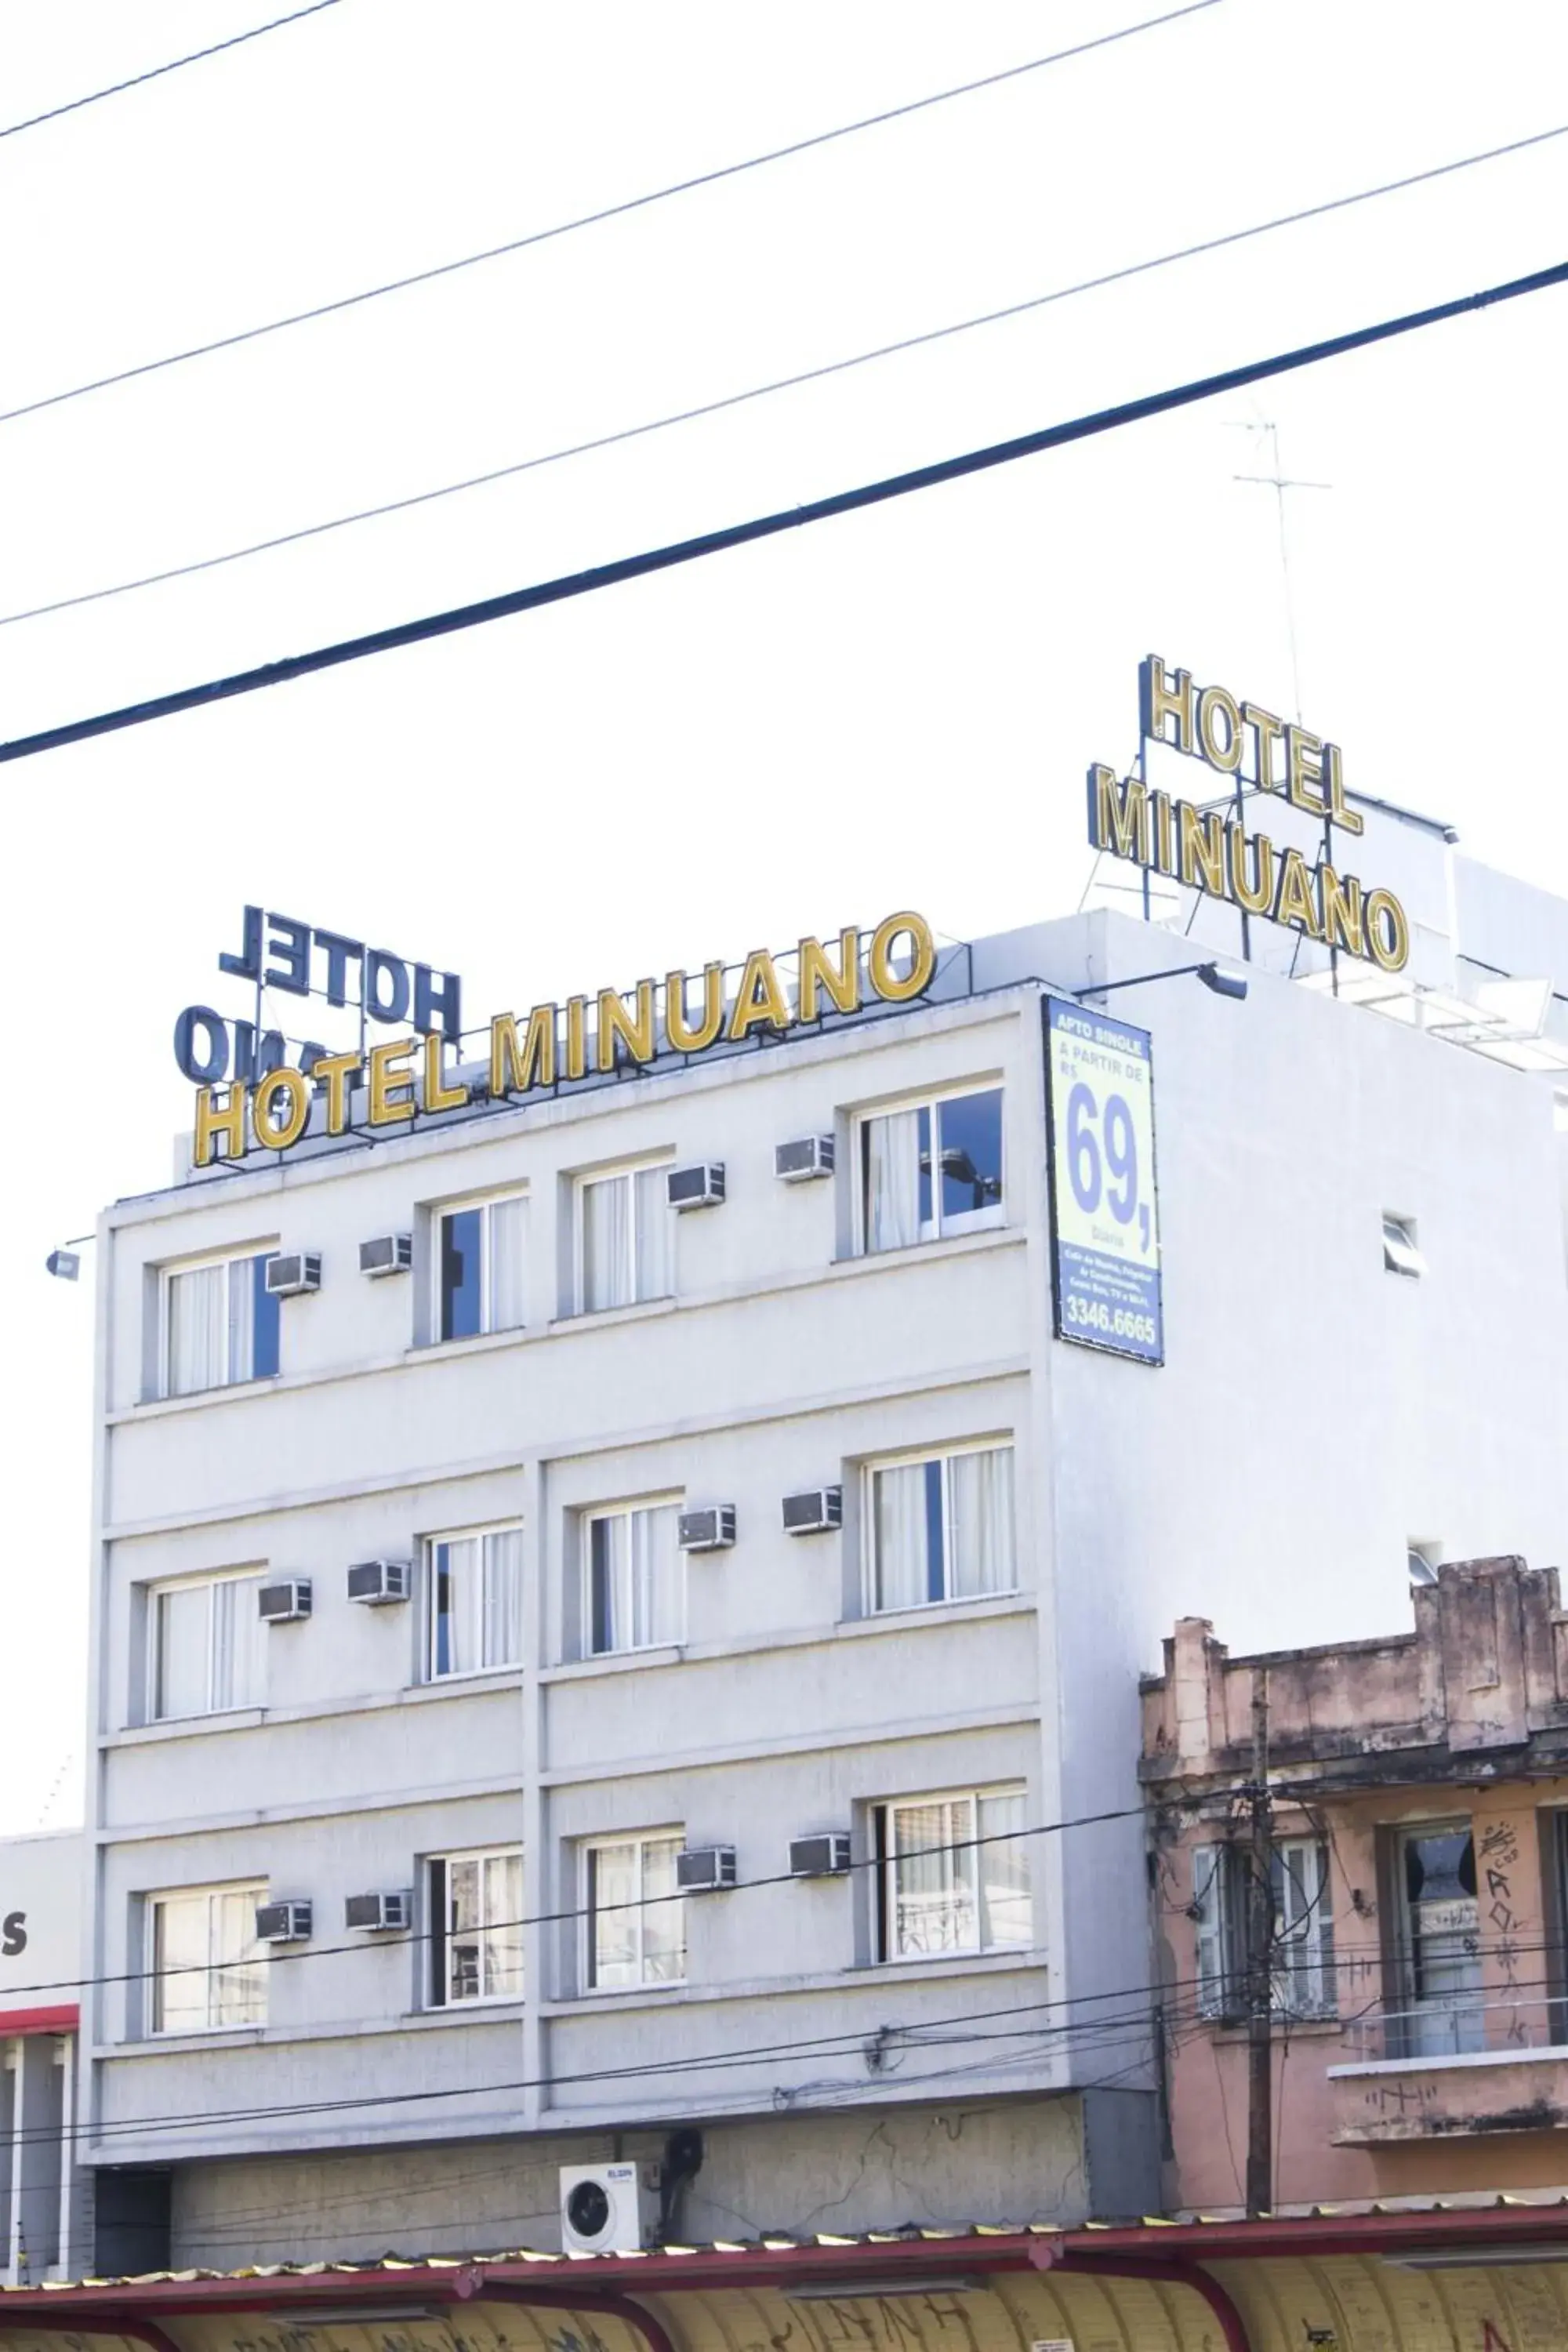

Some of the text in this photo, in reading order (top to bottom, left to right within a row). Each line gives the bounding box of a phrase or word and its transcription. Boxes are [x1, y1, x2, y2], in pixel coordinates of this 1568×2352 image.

[1138, 653, 1363, 836] HOTEL
[1087, 762, 1408, 972] MINUANO
[194, 1029, 470, 1168] HOTEL
[489, 910, 938, 1096] MINUANO
[1057, 1014, 1143, 1056] APTO SINGLE
[1059, 1040, 1142, 1082] A PARTIR DE
[1066, 1295, 1156, 1345] 3346.6665
